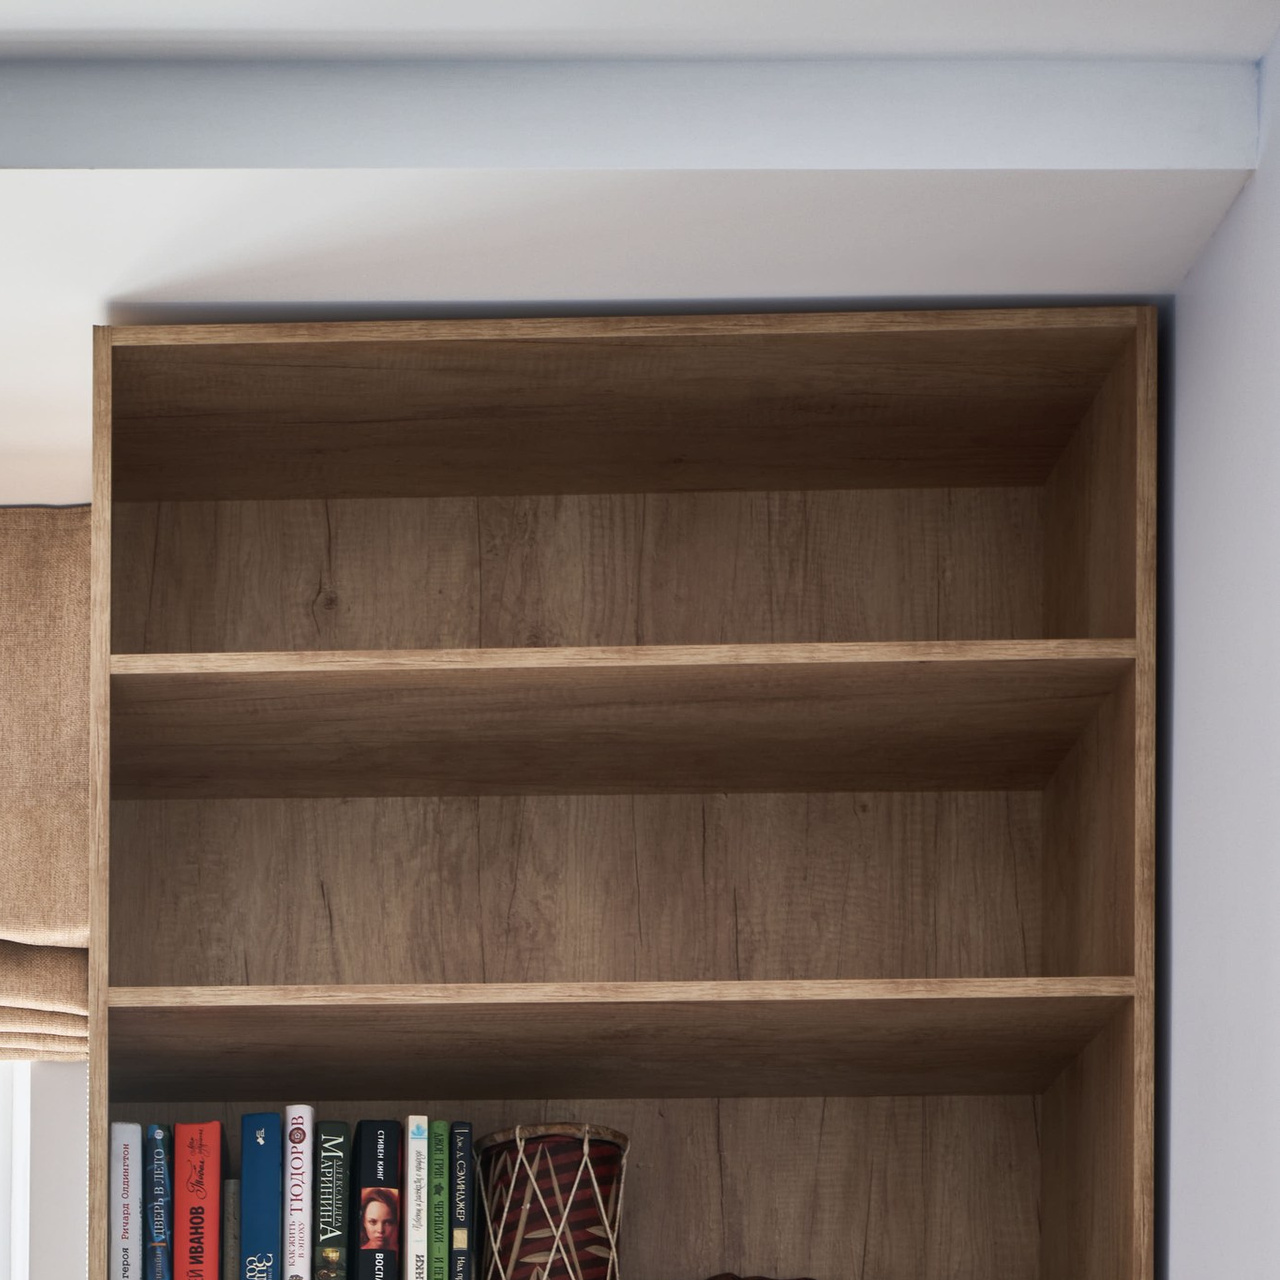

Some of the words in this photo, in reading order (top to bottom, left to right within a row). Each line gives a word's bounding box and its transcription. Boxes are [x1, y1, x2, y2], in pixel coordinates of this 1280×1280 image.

[376, 1130, 385, 1159] СТИВЕН
[433, 1132, 445, 1155] ДЖОН
[122, 1143, 130, 1199] Олдингтон
[154, 1149, 164, 1185] ЛЕТО
[376, 1160, 384, 1180] КИНГ
[433, 1158, 445, 1179] ГРИН
[154, 1187, 164, 1195] В
[335, 1160, 343, 1227] АЛЕКСАНДРА
[456, 1160, 466, 1221] СЭЛИНДЖЕР
[121, 1203, 130, 1240] Ричард
[154, 1198, 165, 1240] ДВЕРЬ
[189, 1206, 205, 1265] ИВАНОВ
[433, 1201, 445, 1243] ЧЕРЕПАХИ
[122, 1247, 130, 1279] героя
[456, 1256, 466, 1271] Над
